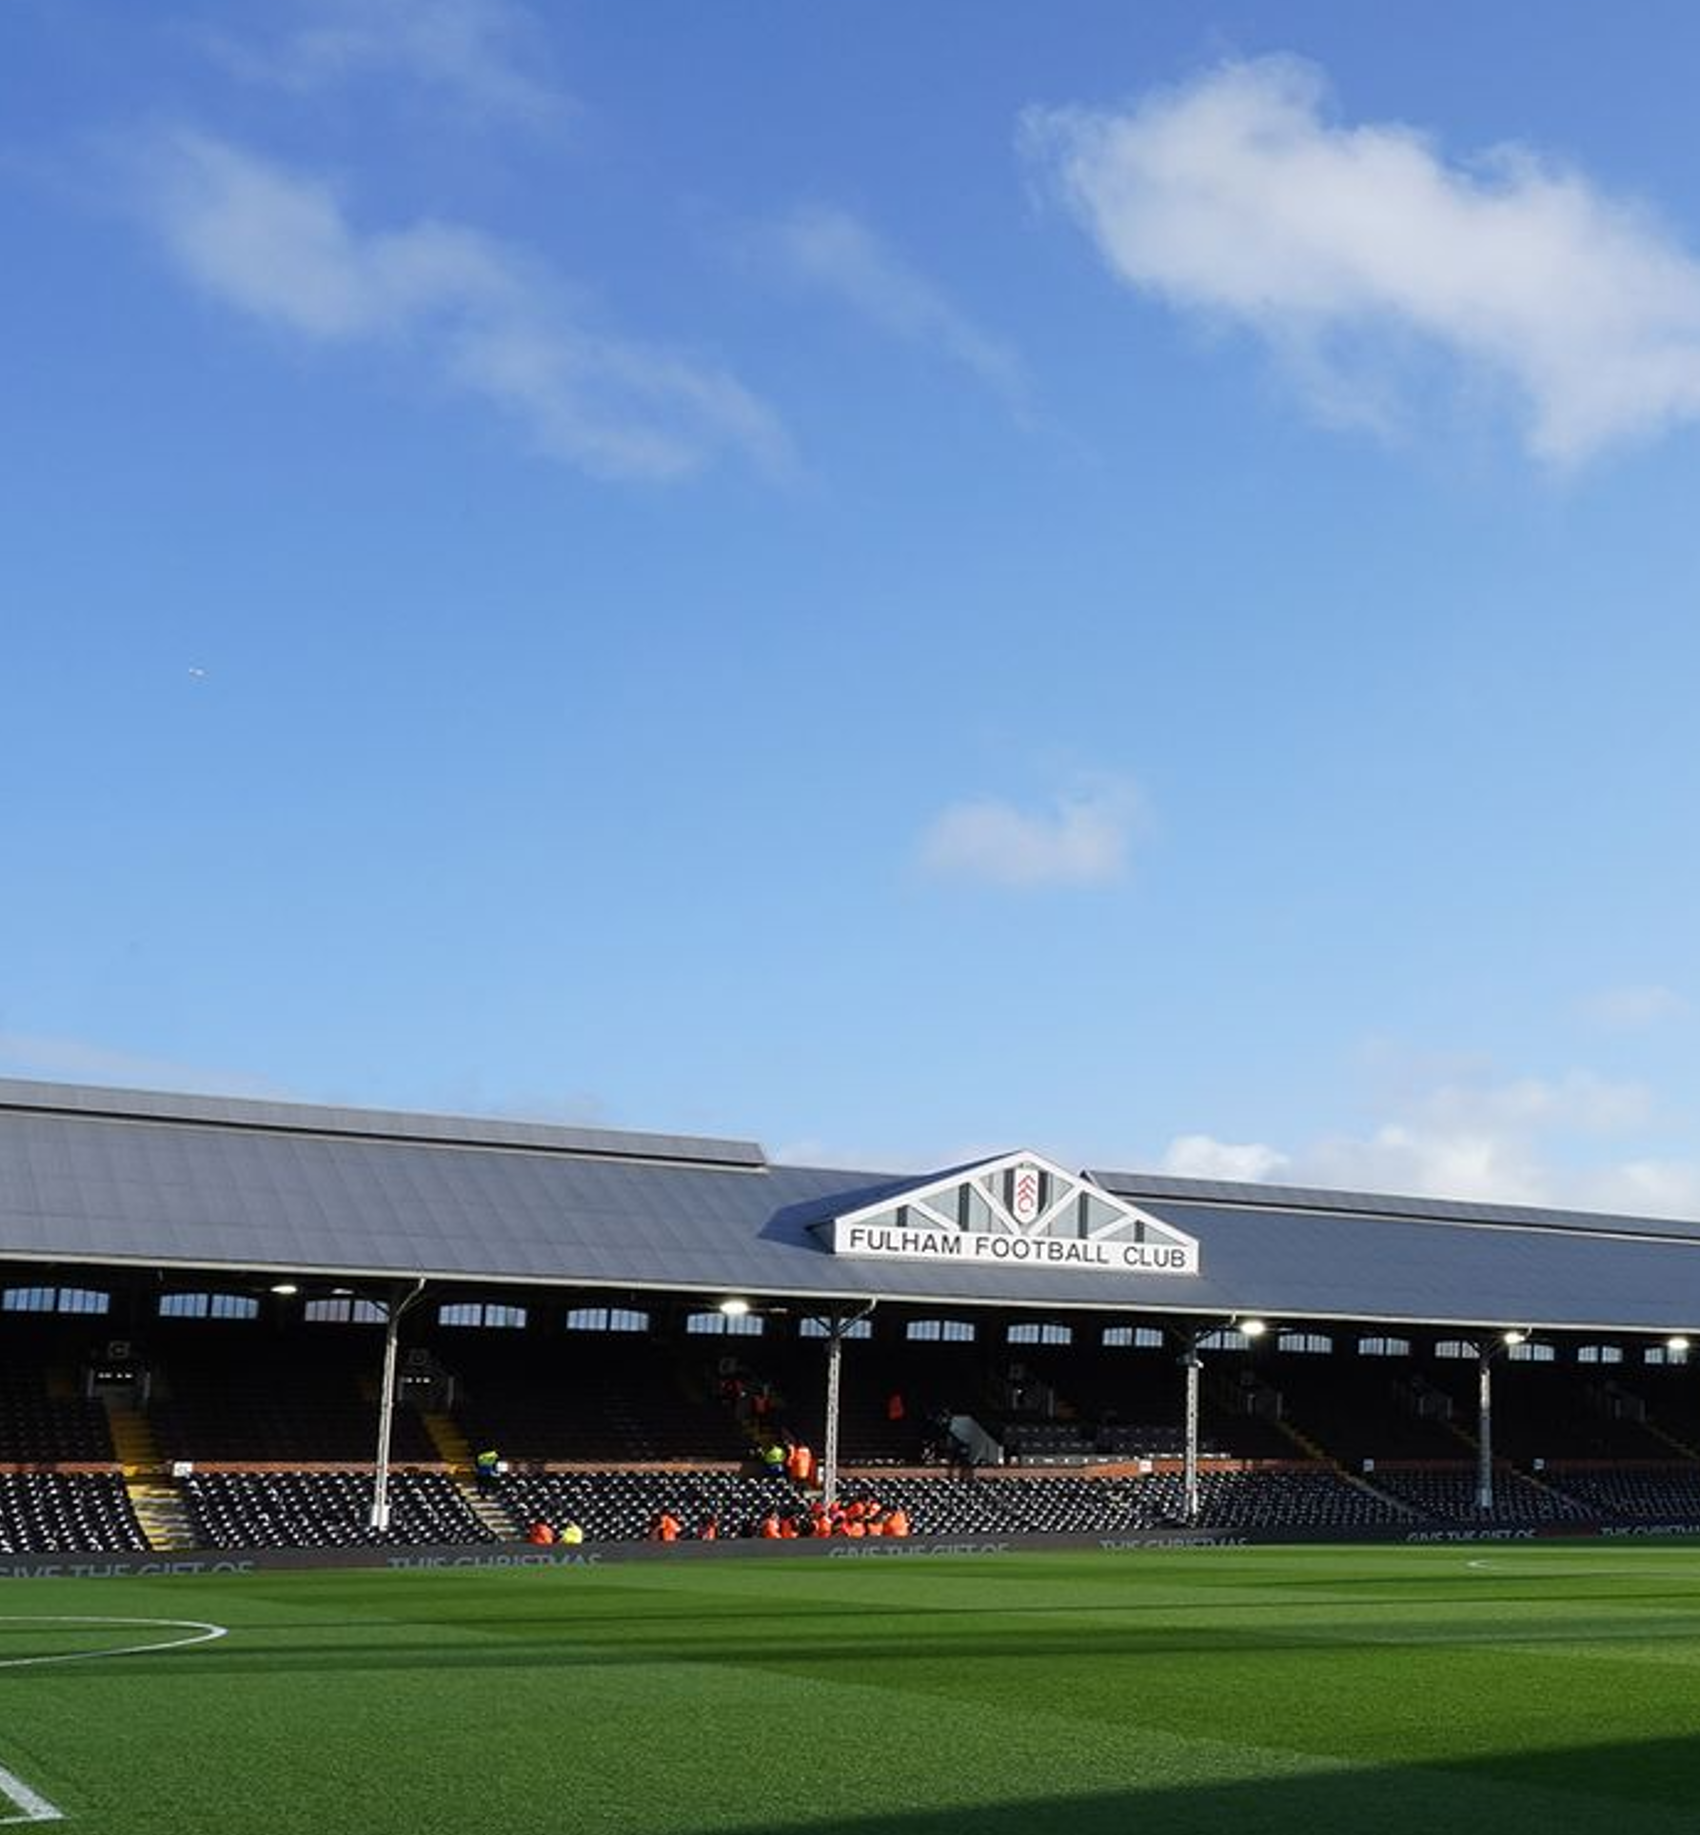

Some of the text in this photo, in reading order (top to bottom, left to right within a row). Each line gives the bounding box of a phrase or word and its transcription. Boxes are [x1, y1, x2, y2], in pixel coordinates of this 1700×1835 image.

[850, 1228, 1187, 1269] FULHAM FOOTBALL CLUB
